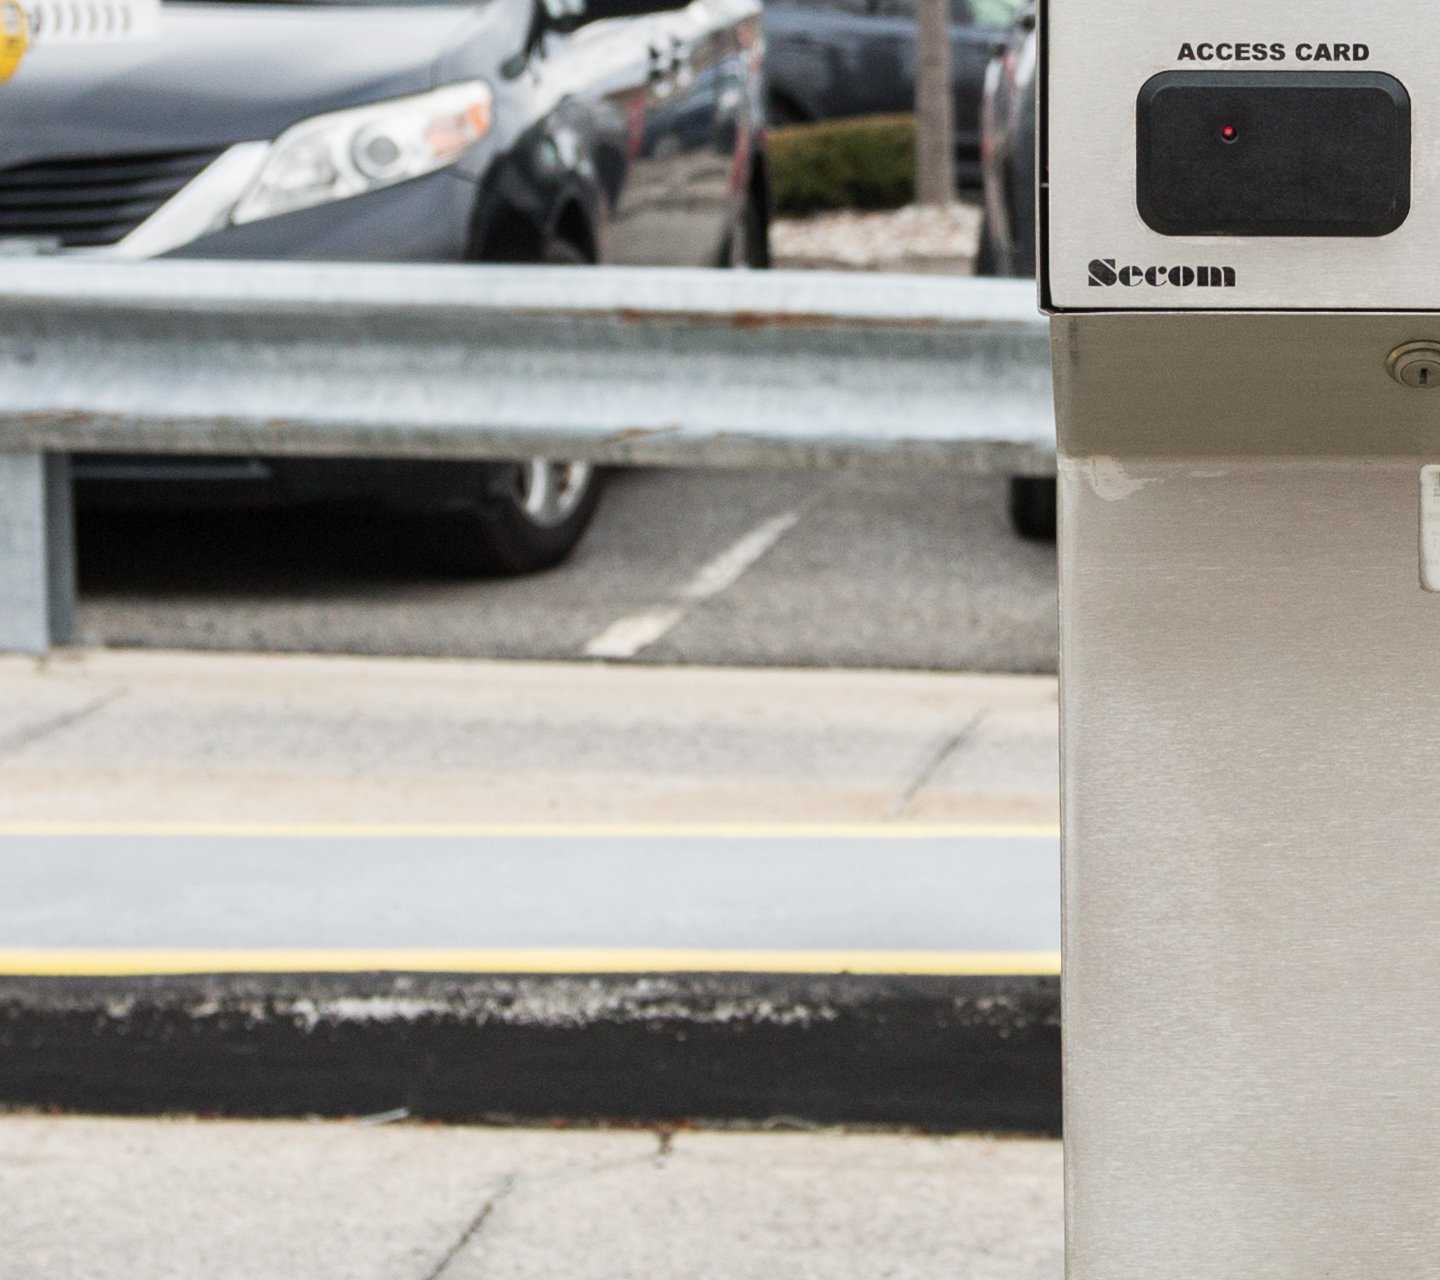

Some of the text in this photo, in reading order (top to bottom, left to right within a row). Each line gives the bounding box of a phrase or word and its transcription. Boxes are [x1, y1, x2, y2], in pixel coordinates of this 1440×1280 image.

[1177, 43, 1370, 62] ACCESS CARD
[1087, 258, 1236, 288] Secom
